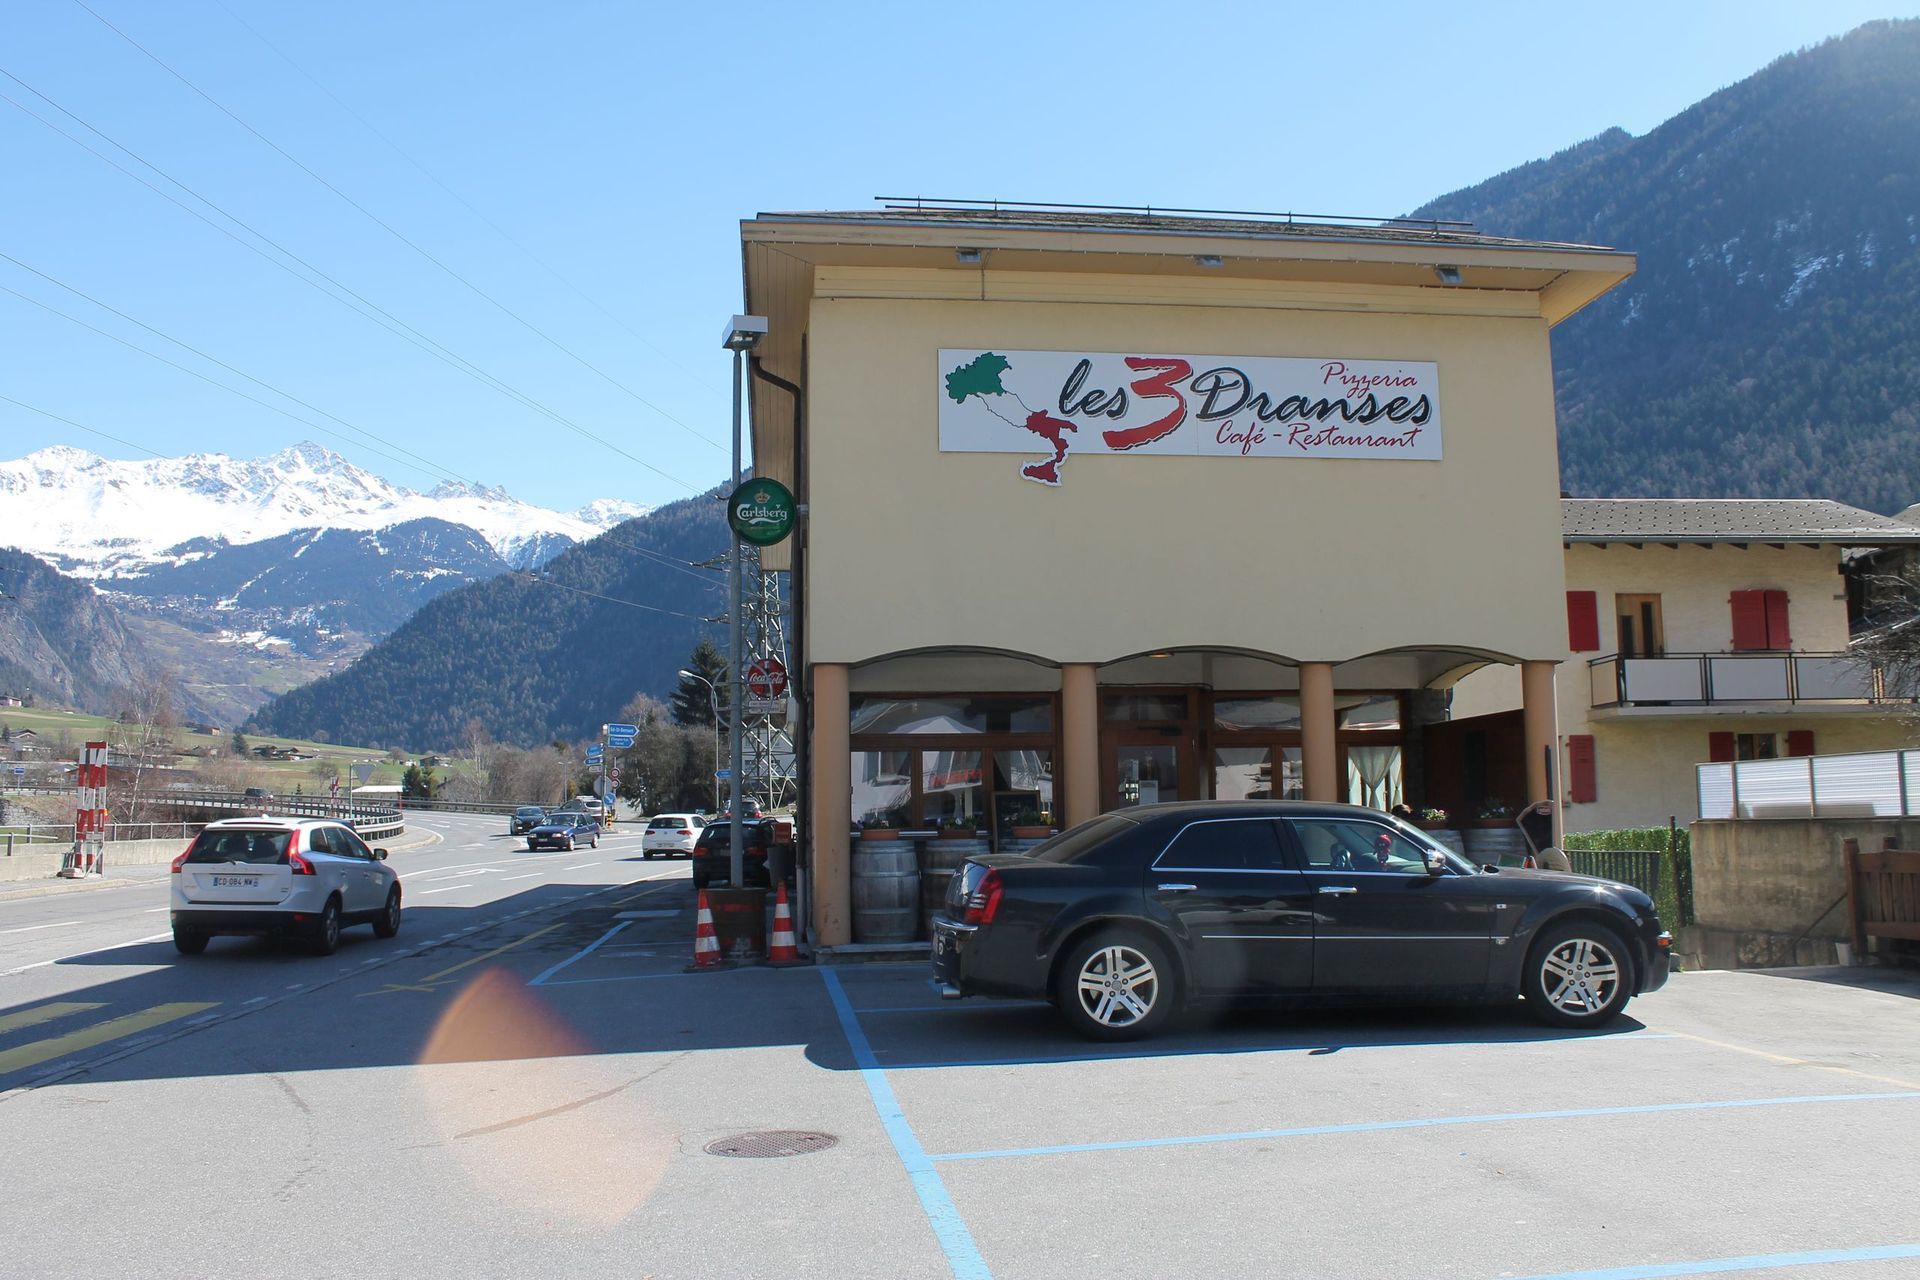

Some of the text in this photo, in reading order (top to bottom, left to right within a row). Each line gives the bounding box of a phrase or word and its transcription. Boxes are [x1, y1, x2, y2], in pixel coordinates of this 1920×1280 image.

[1320, 361, 1418, 398] Pizzeria
[1058, 356, 1432, 451] les 3 Dranses
[736, 503, 788, 523] Carlsberg
[749, 671, 785, 685] CocaCola
